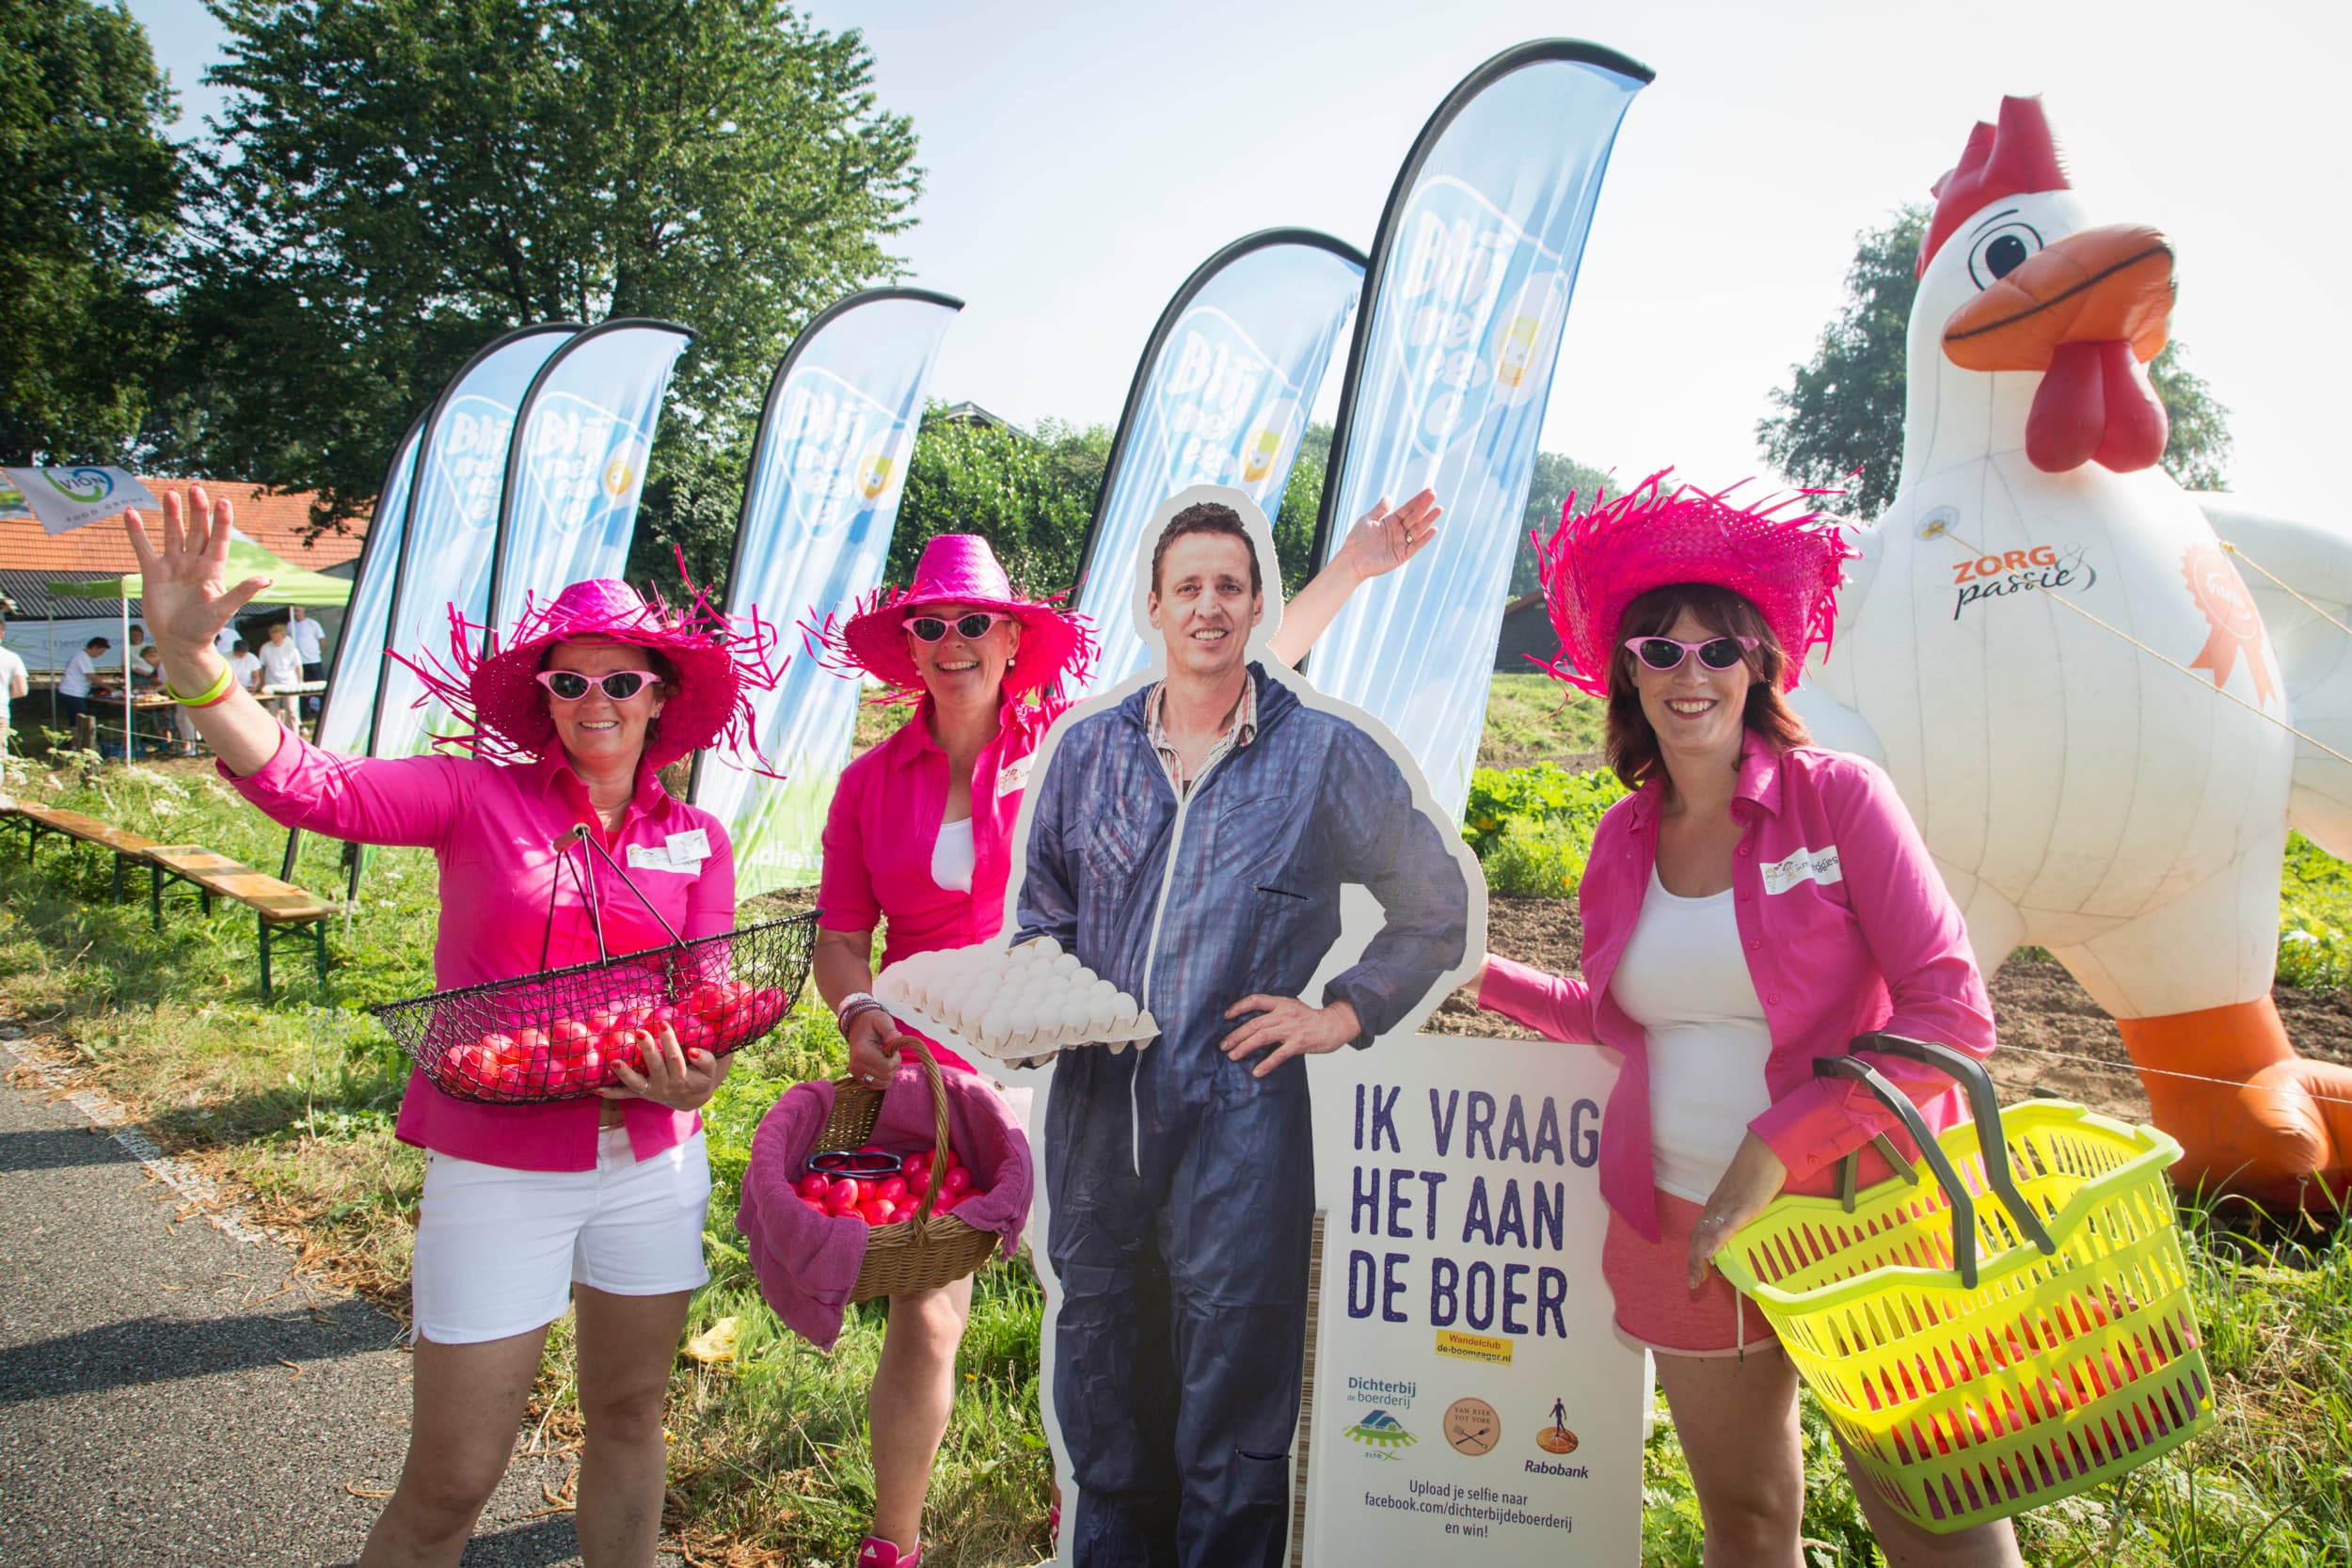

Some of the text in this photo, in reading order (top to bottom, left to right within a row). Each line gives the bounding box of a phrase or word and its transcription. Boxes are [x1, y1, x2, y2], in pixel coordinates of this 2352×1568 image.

[1952, 546, 2056, 584] ZORG
[1954, 566, 2074, 621] passie
[1354, 1083, 1599, 1168] IK VRAAG
[1351, 1165, 1565, 1251] HET AAN
[1347, 1249, 1567, 1338] DE BOER
[1437, 1344, 1511, 1362] de-boomzager.nl
[1449, 1334, 1502, 1349] Wandelclub
[1348, 1376, 1417, 1398] Dichterbij
[1347, 1391, 1411, 1409] de boerderij
[1454, 1406, 1470, 1415] VAN
[1524, 1460, 1589, 1479] Rabobank
[1409, 1479, 1529, 1506] Upload je selfie naar
[1364, 1492, 1573, 1533] facebook.com/dichterbijdeboerderij
[1444, 1523, 1488, 1538] en win!
